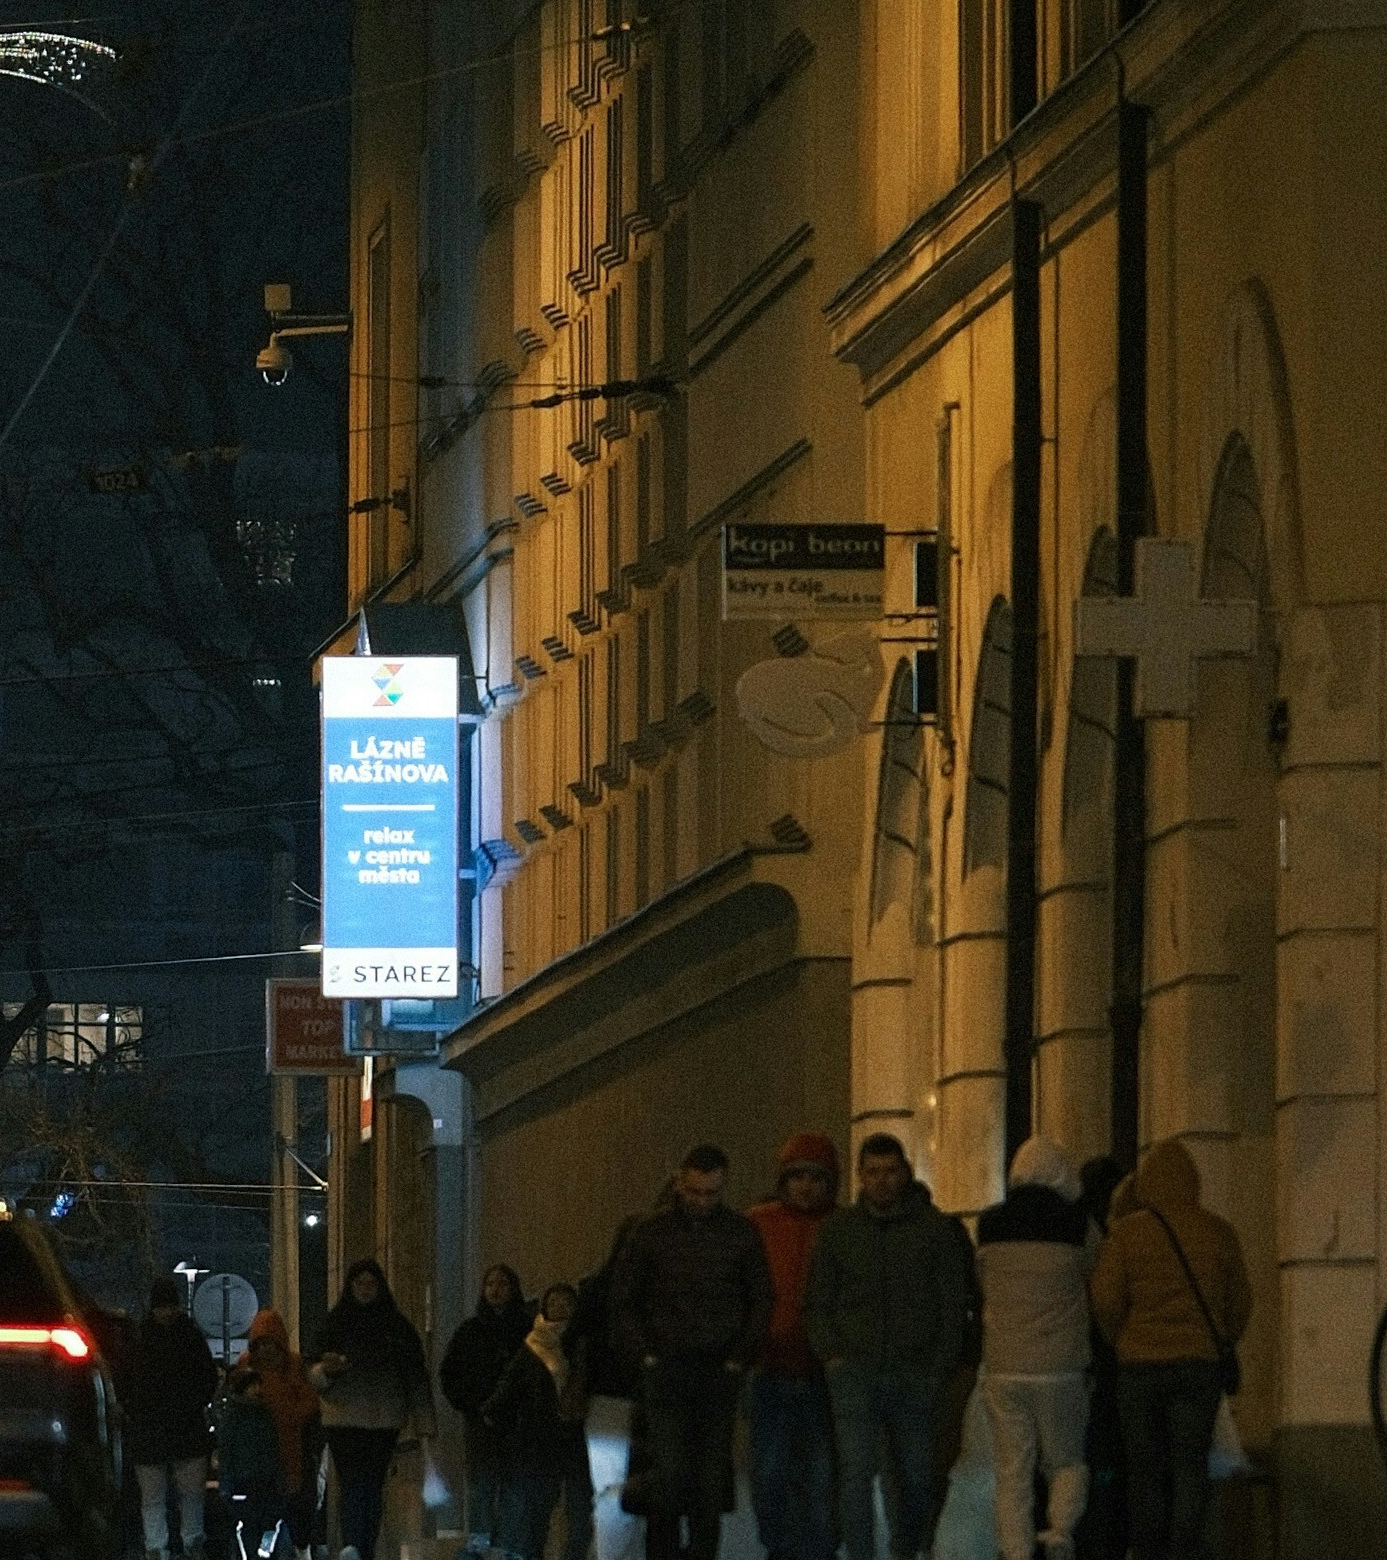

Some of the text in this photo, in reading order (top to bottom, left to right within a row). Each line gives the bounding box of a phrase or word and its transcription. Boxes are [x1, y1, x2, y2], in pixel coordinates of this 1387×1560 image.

[729, 528, 881, 562] kopi bean
[775, 582, 785, 593] a
[350, 736, 426, 759] LÁZNĚ
[328, 760, 449, 783] RAŠÍNOVA
[363, 826, 415, 844] relax
[348, 848, 431, 865] v centru
[358, 865, 420, 884] města
[353, 965, 451, 983] STAREZ
